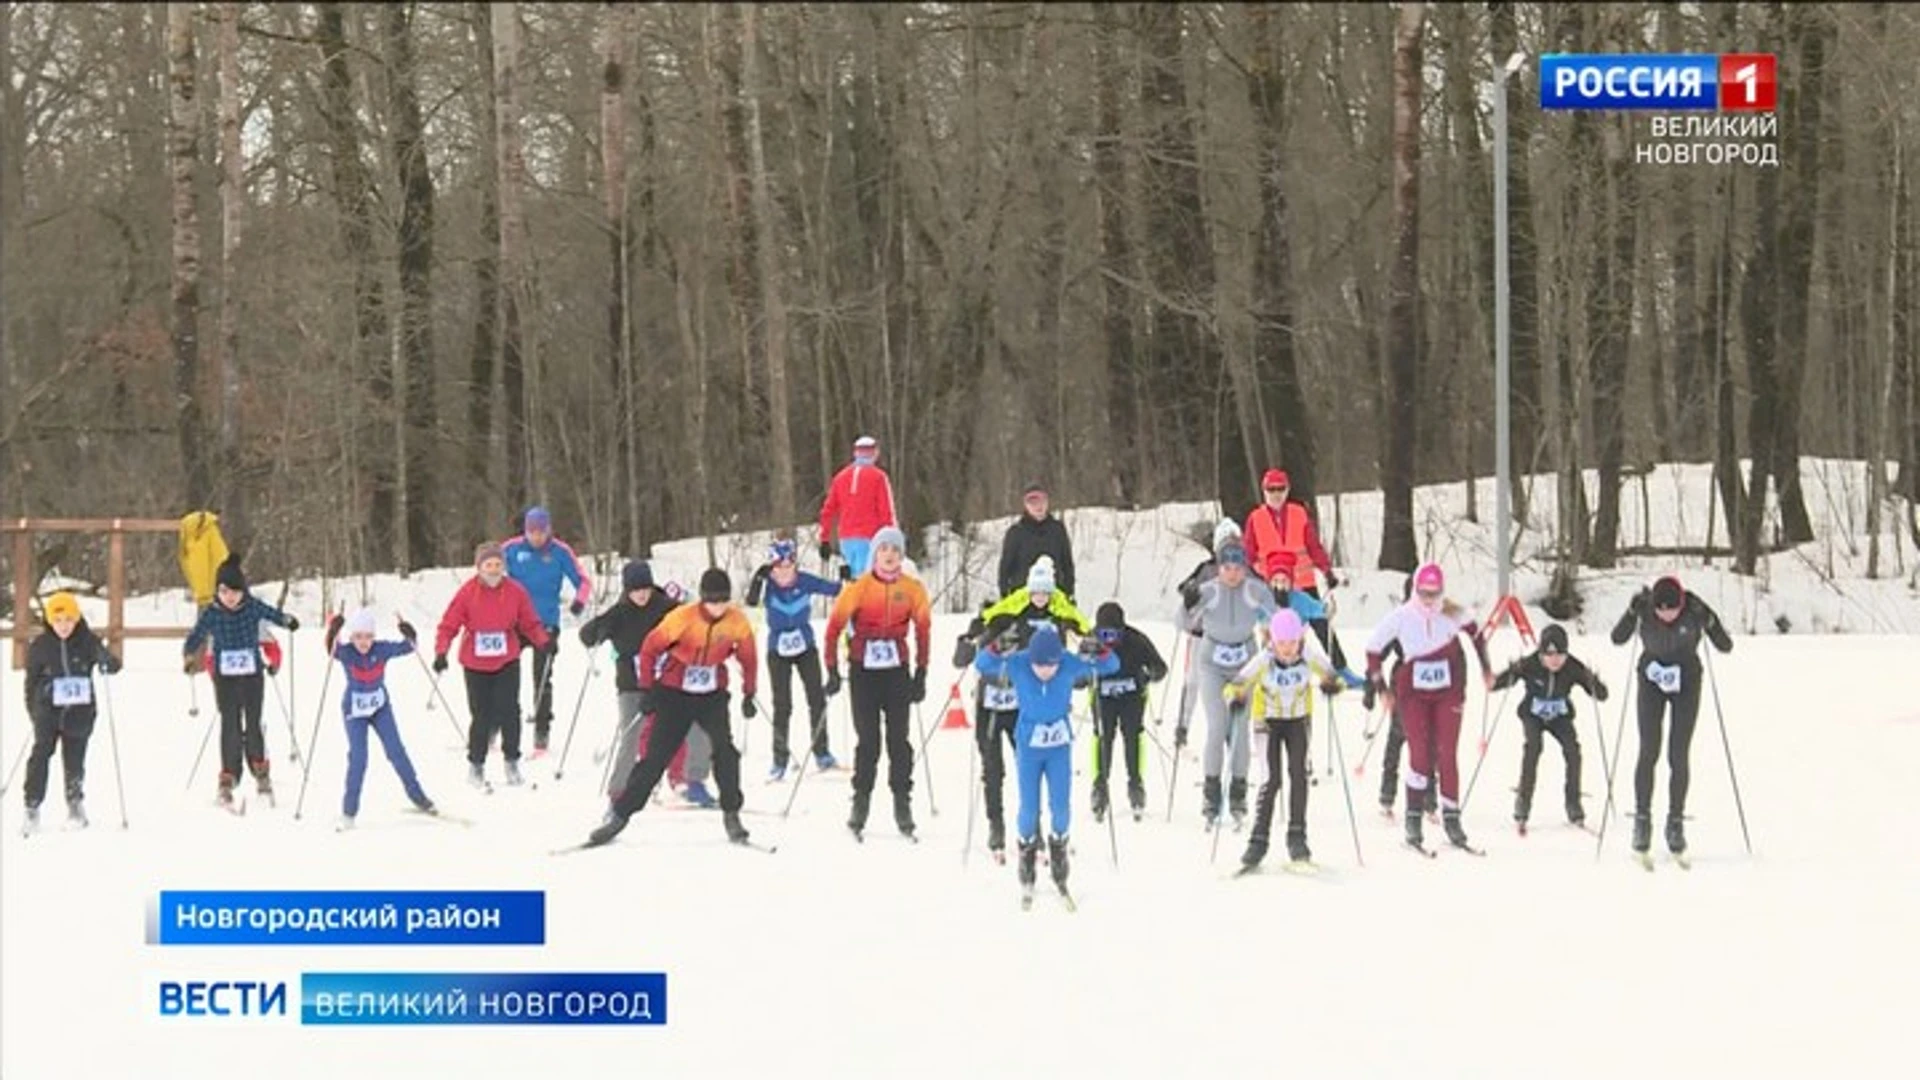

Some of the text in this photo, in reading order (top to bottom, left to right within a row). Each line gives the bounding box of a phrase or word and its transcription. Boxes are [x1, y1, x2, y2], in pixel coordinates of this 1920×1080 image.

[481, 636, 504, 651] 56
[783, 634, 806, 651] 50
[225, 654, 249, 670] 52
[686, 667, 711, 687] 59
